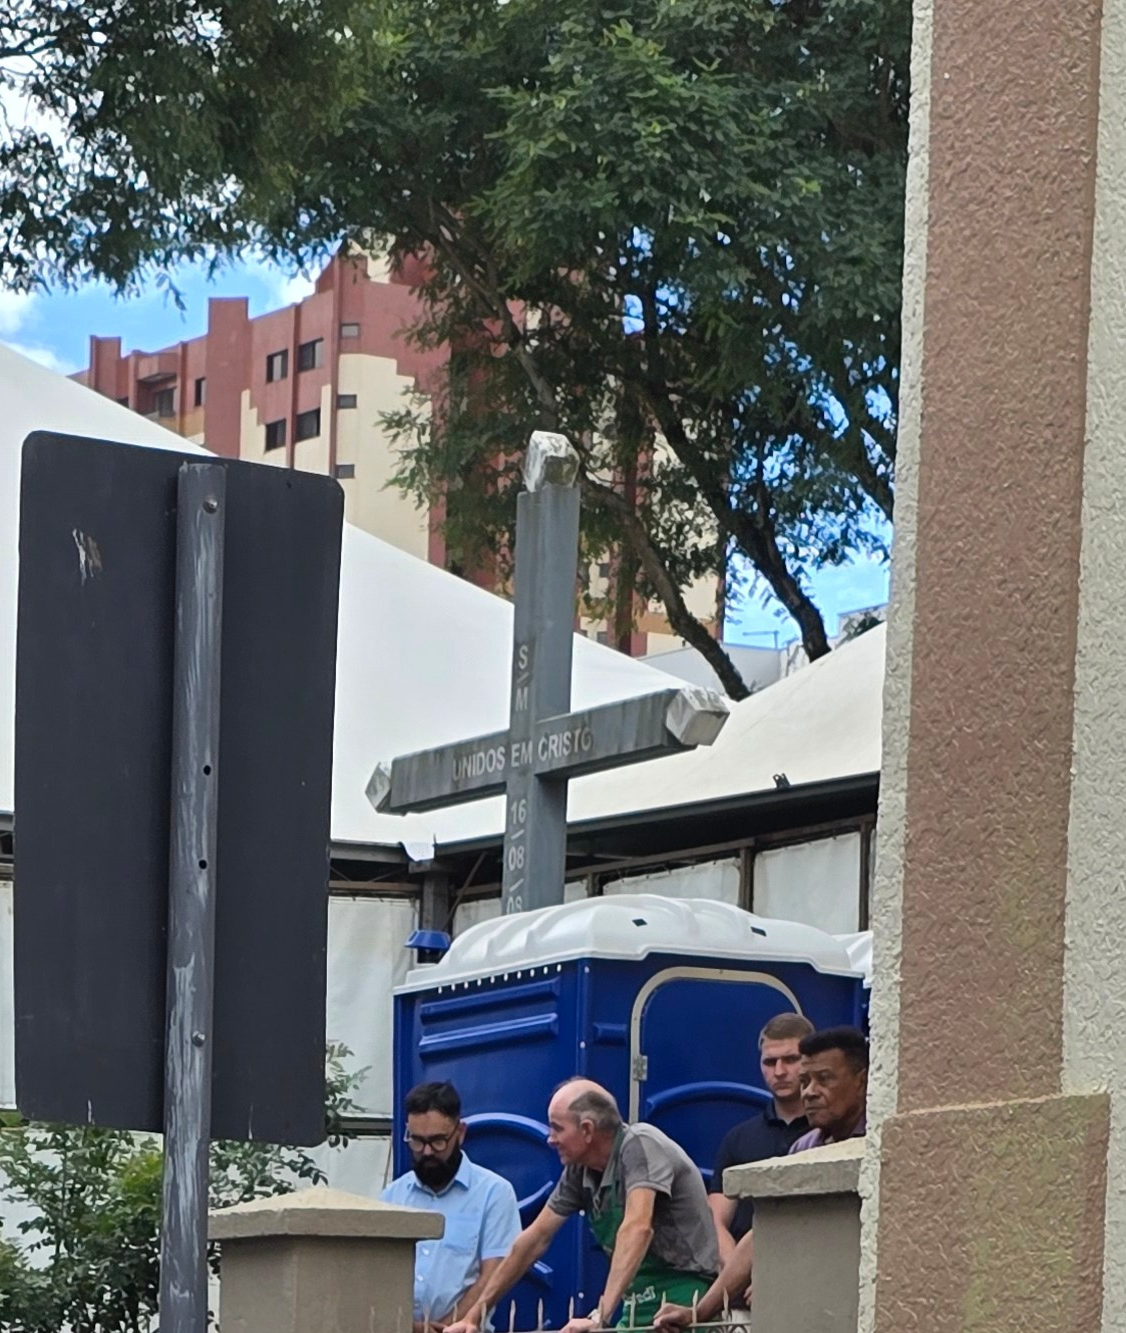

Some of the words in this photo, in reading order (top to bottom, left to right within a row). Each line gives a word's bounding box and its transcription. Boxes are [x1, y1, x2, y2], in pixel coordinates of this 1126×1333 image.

[452, 746, 505, 781] UNIDOS
[511, 741, 533, 767] EM
[537, 727, 592, 762] CRISTO
